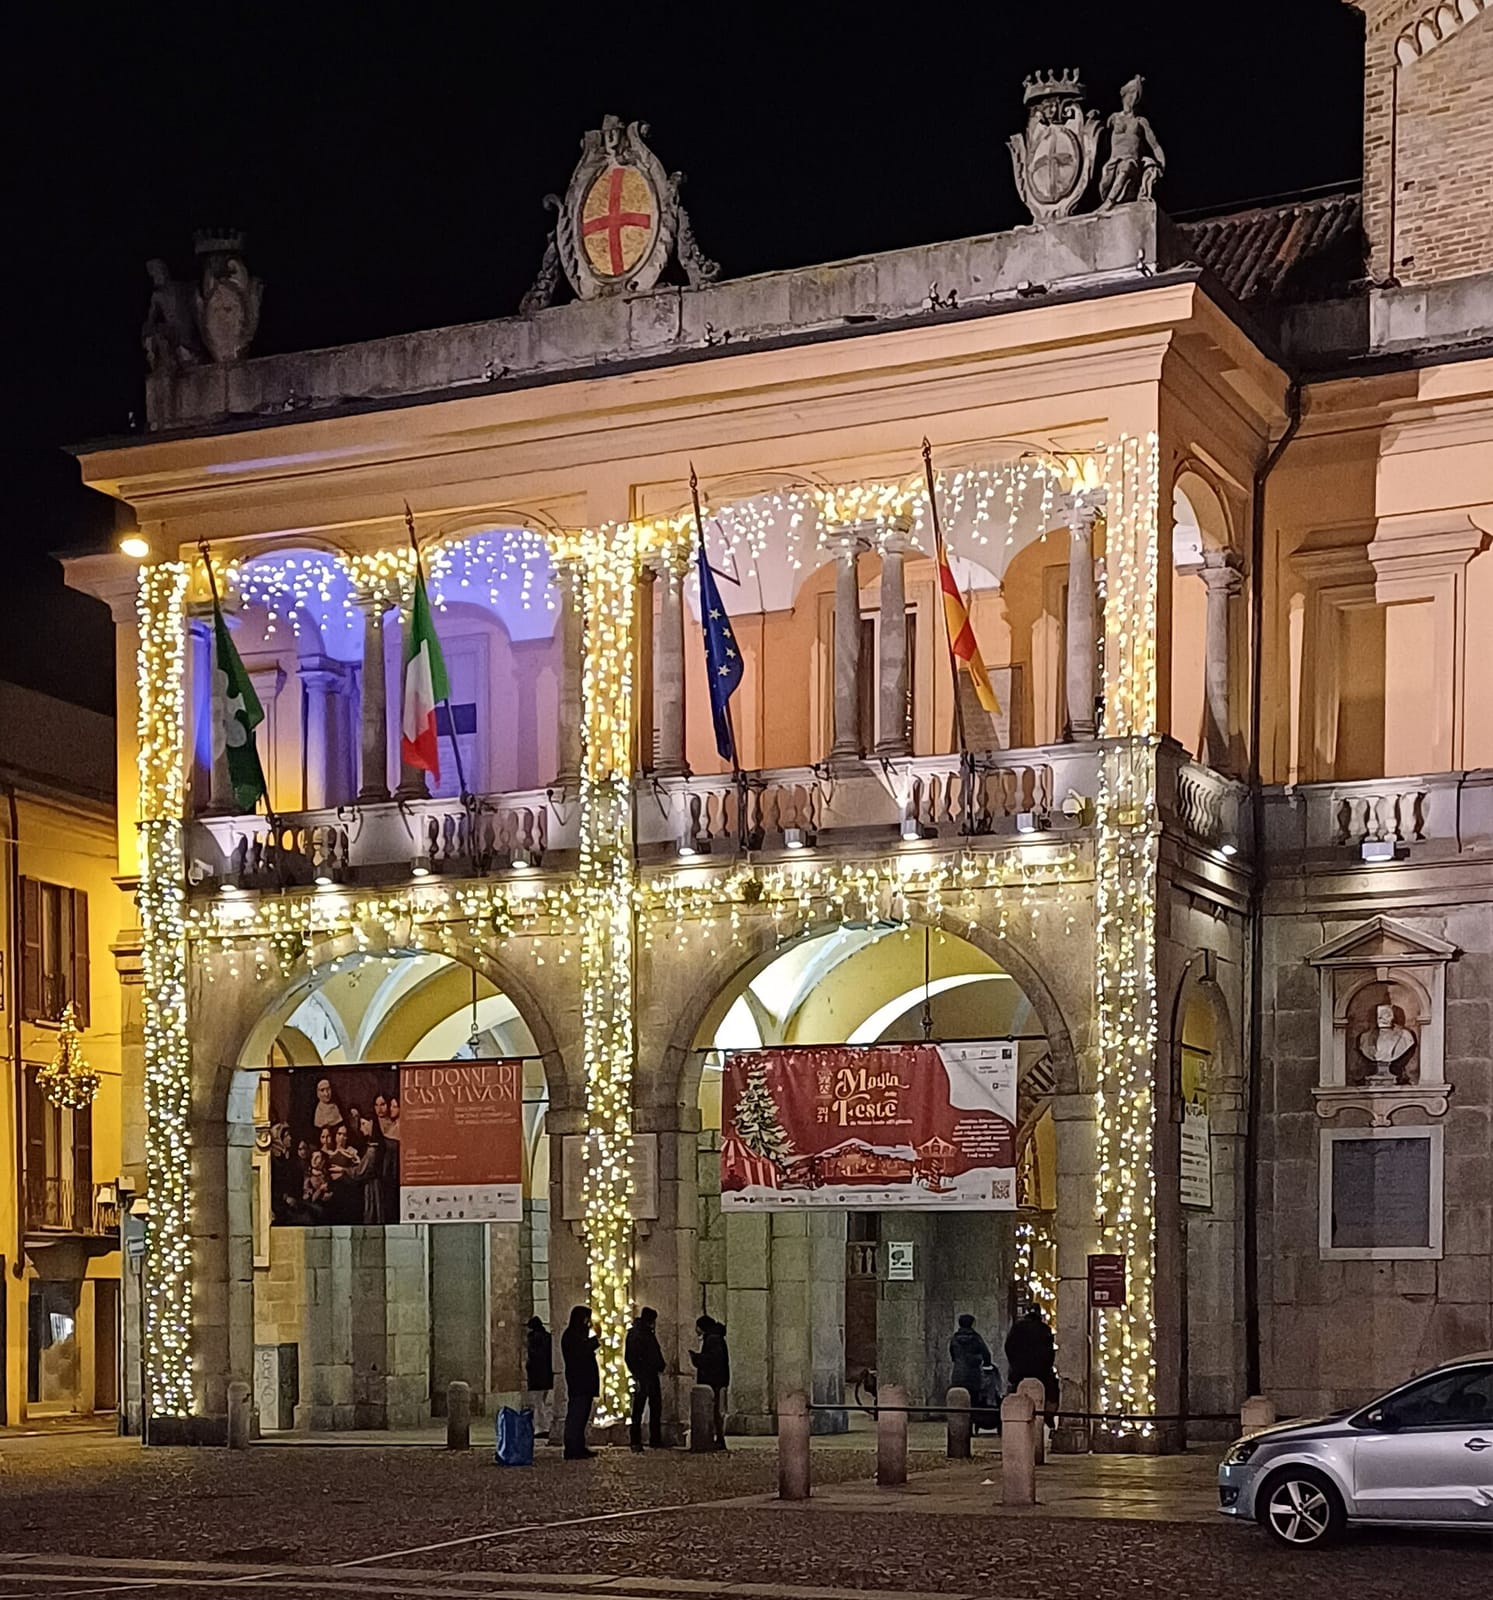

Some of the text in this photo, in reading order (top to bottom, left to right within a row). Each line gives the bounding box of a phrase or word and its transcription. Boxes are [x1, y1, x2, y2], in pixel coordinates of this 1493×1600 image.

[404, 1065, 517, 1088] LE DONNE DI
[404, 1086, 445, 1105] CASA
